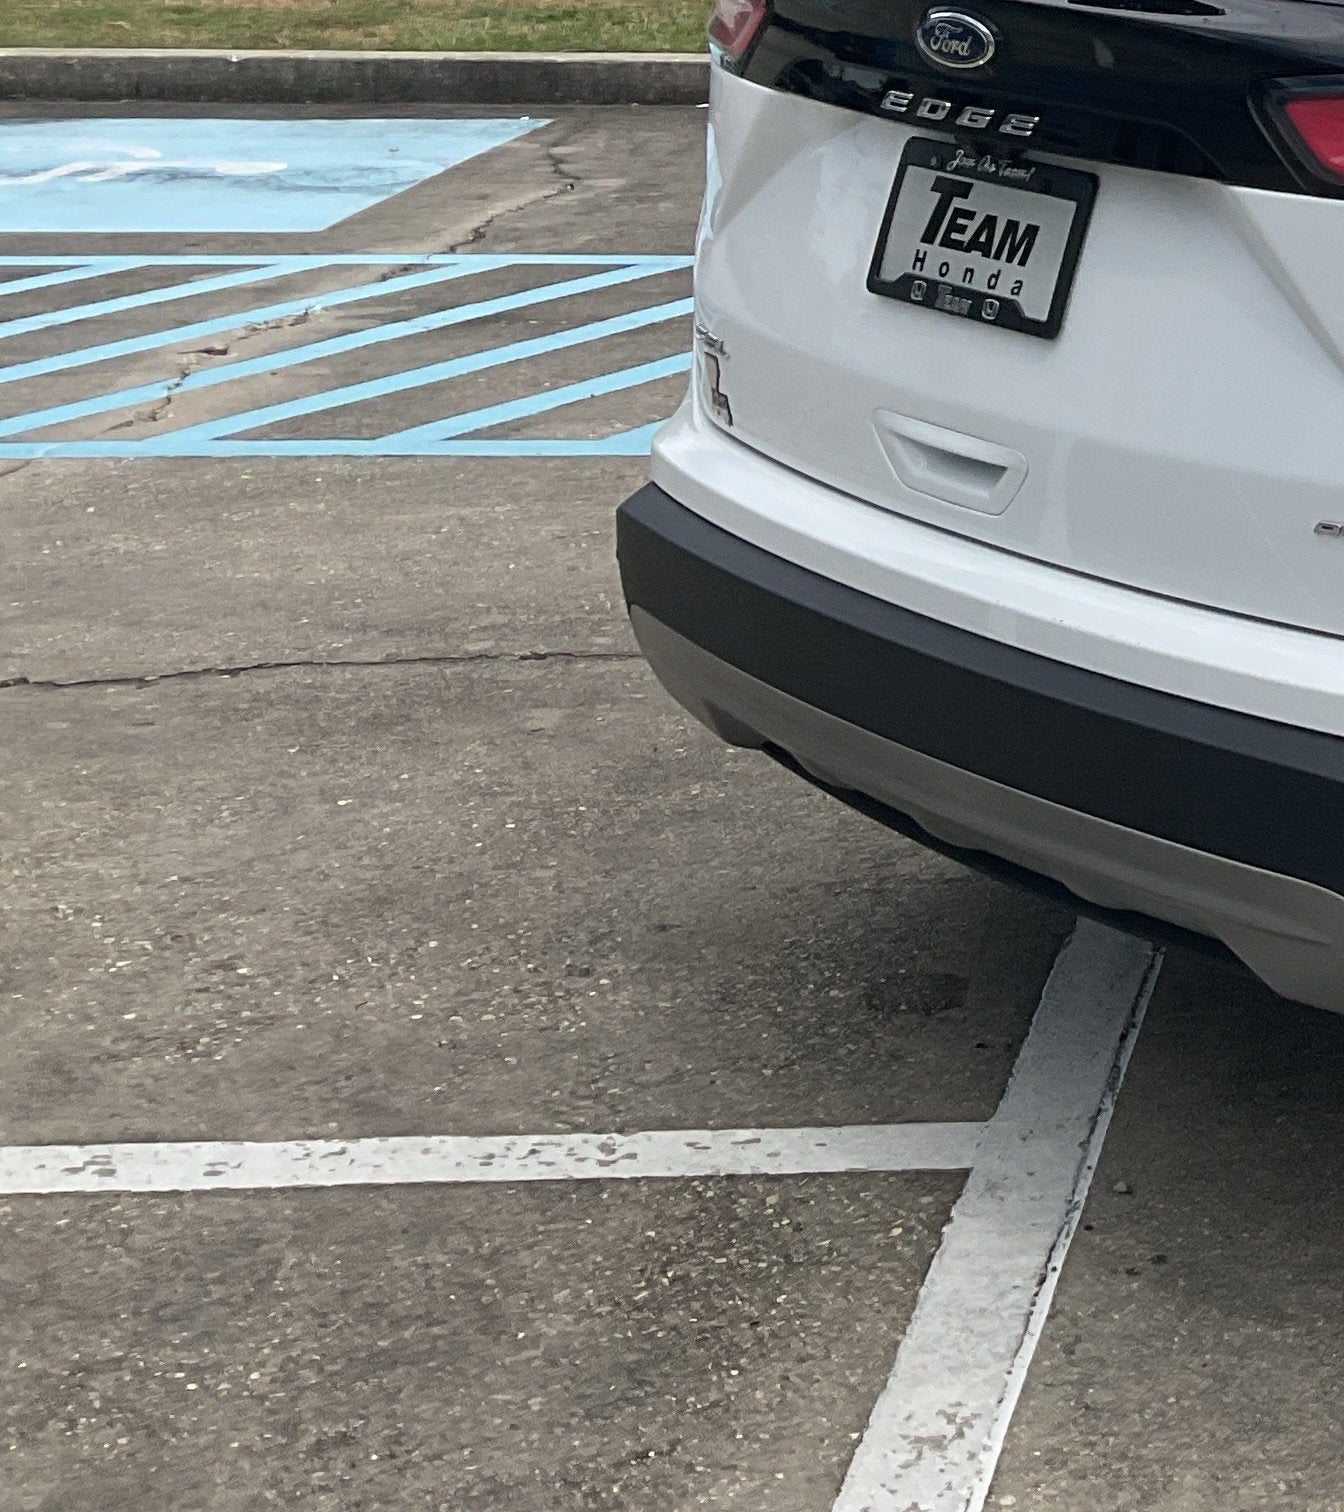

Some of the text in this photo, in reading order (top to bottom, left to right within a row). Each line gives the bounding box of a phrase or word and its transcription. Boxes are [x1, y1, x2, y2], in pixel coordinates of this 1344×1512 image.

[930, 23, 974, 57] Ford
[879, 90, 1040, 137] EDGE
[919, 175, 1041, 267] TEAM
[912, 248, 1024, 296] Honda
